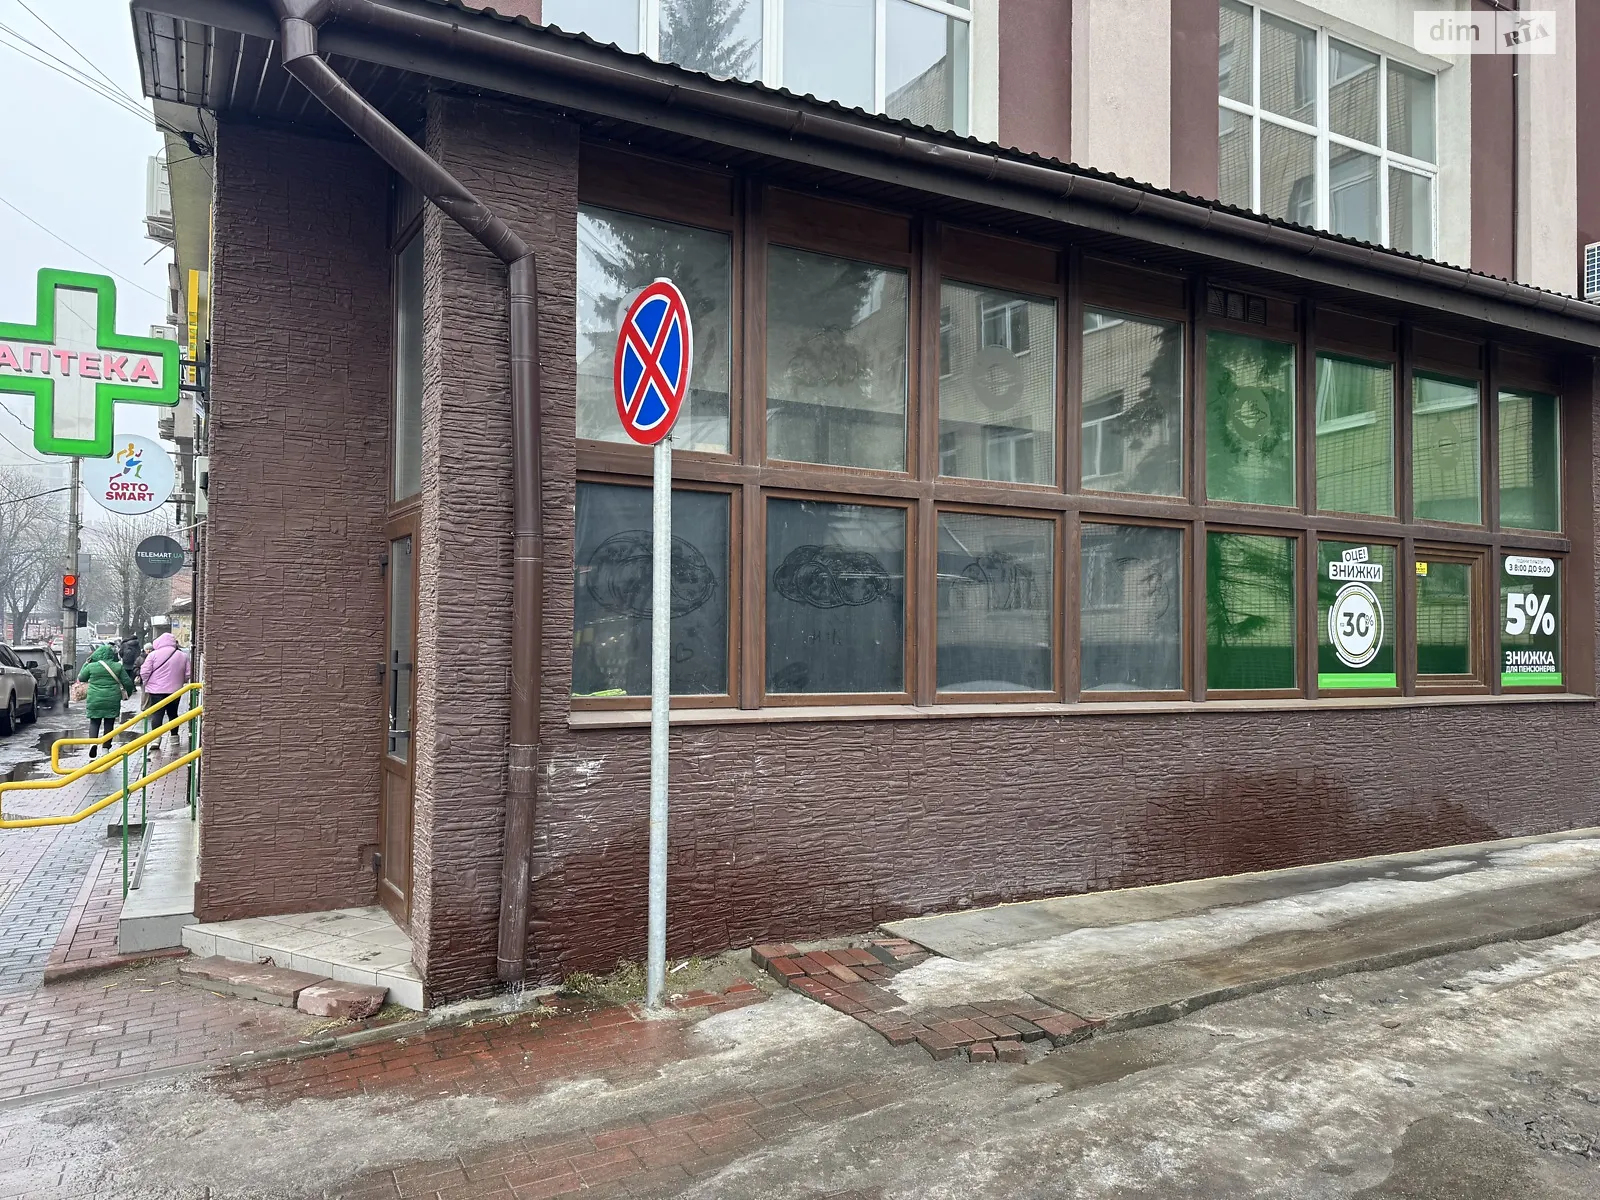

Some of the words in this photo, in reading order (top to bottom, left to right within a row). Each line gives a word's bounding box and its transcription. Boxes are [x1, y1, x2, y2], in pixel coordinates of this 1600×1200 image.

[0, 344, 159, 385] АПТЕКА
[109, 482, 149, 492] ORTO
[105, 491, 155, 502] SMART
[1344, 549, 1366, 562] ОЦЕ!
[1331, 564, 1381, 580] ЗНИЖКИ
[1505, 592, 1555, 636] 5%
[1505, 650, 1556, 665] ЗНИЖКА
[1505, 665, 1518, 674] ДЛЯ
